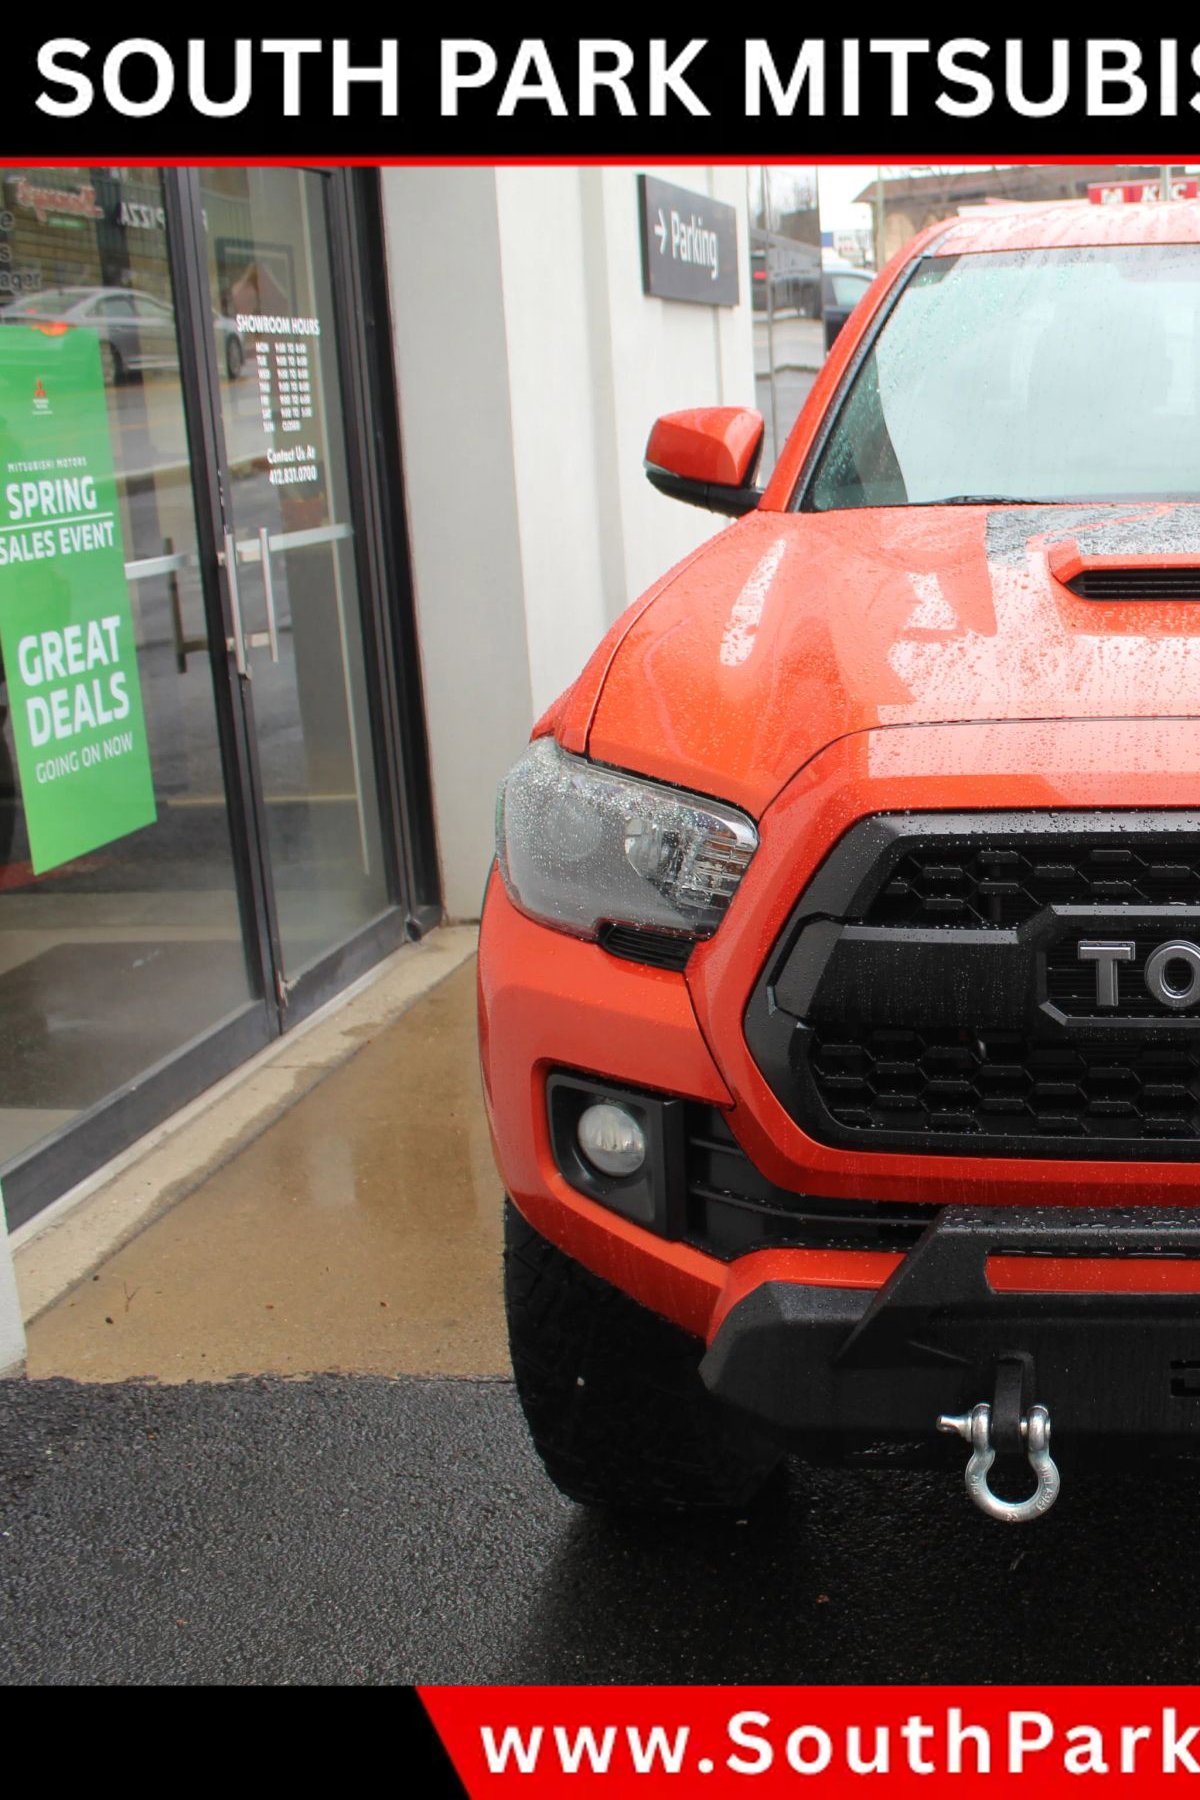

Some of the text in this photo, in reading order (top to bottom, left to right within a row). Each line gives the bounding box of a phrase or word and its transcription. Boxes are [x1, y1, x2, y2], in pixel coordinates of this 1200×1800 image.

[671, 210, 718, 280] Parking
[236, 314, 320, 336] SHOWROOM HOURS
[267, 443, 316, 464] Contact Us At
[269, 464, 318, 485] 412.831.0700
[6, 475, 97, 520] SPRING
[0, 521, 113, 565] SALES EVENT
[18, 615, 121, 687] GREAT
[26, 671, 130, 748] DEALS
[36, 733, 133, 783] GOING ON NOW
